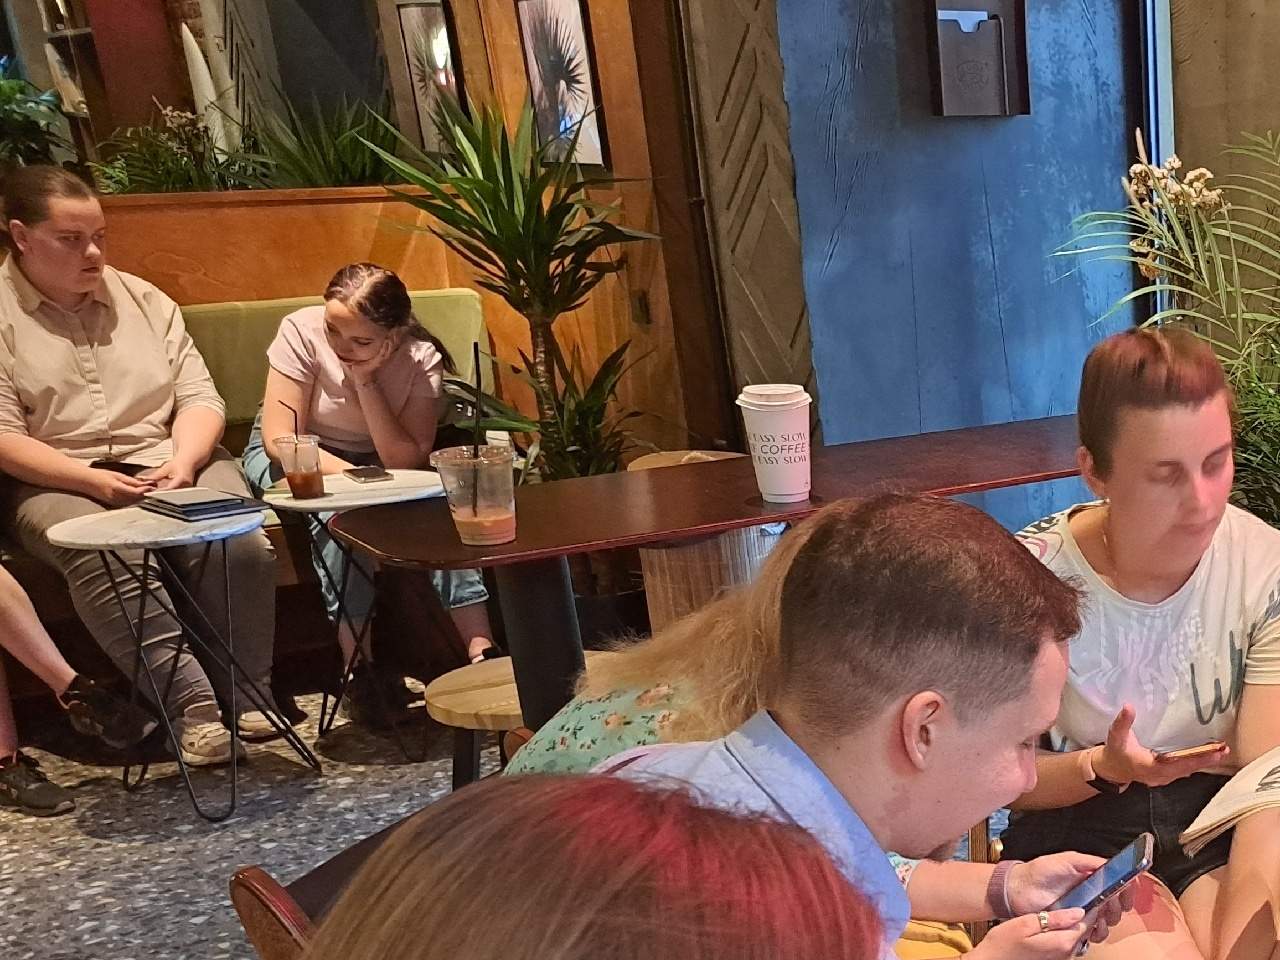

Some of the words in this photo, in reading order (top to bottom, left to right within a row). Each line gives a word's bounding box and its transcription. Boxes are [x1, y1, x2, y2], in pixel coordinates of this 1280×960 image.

[781, 432, 807, 442] SLOW
[760, 442, 807, 455] COFFEE
[757, 455, 779, 465] EASY
[783, 455, 807, 465] SLOW
